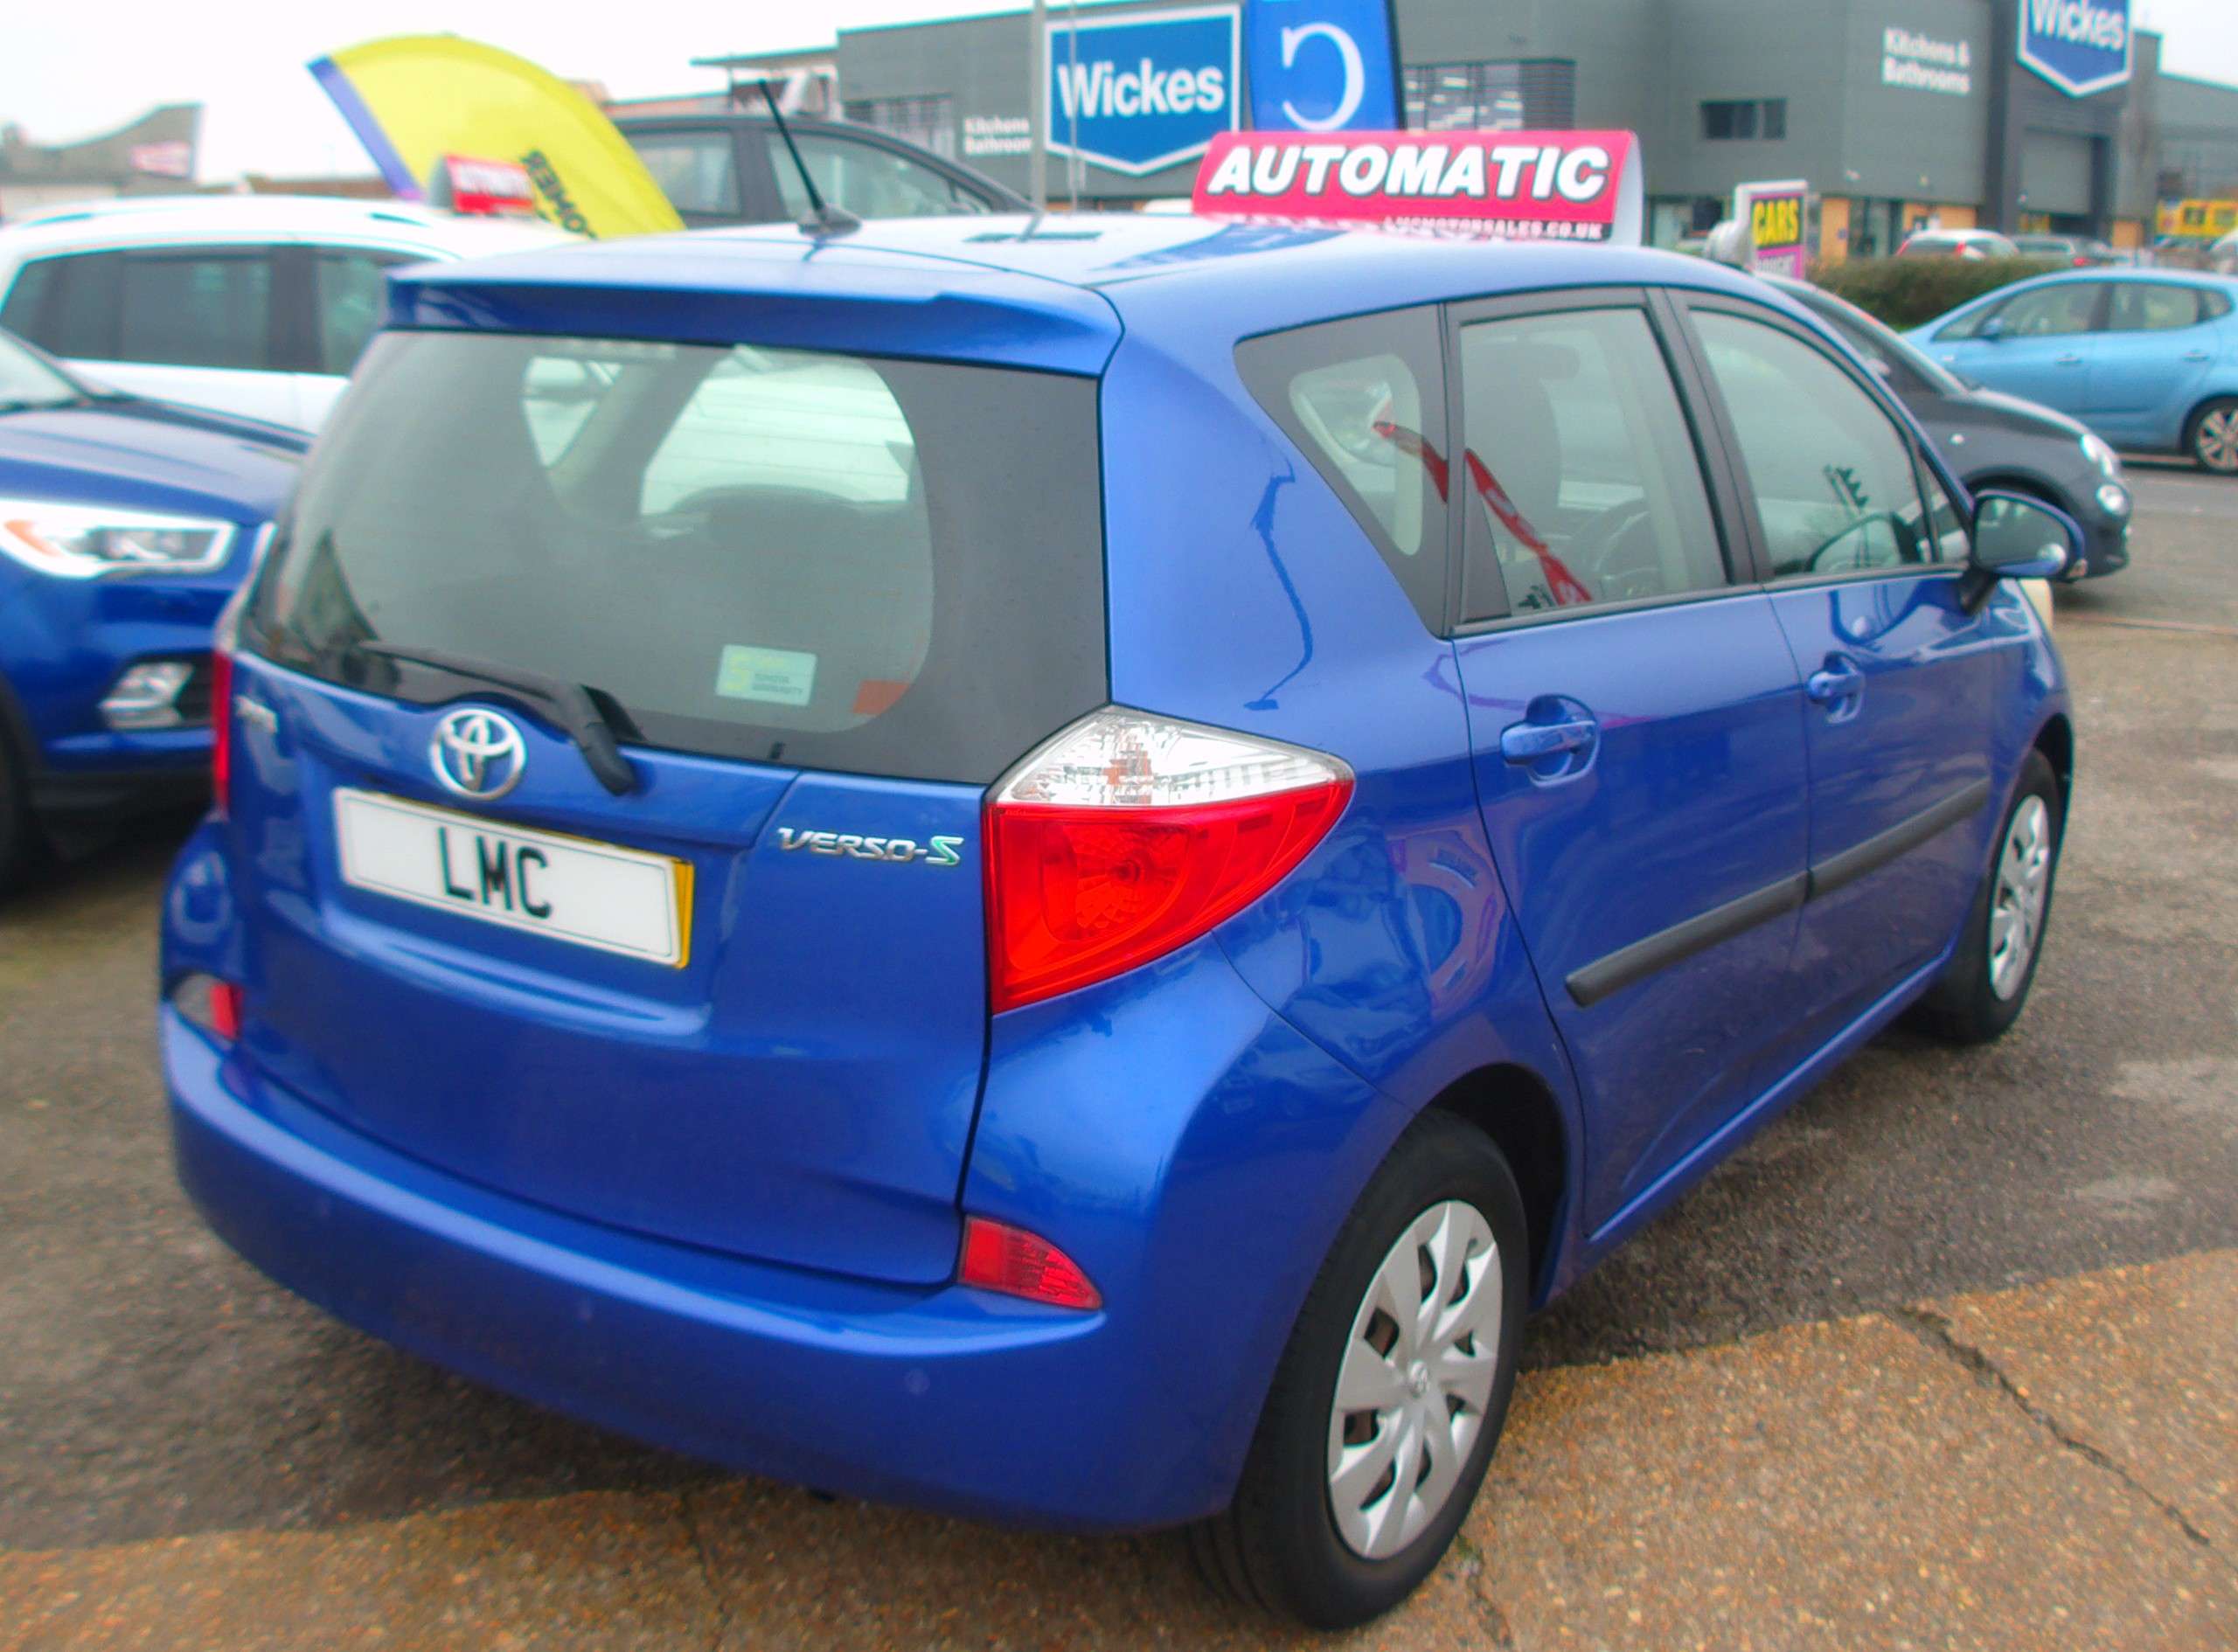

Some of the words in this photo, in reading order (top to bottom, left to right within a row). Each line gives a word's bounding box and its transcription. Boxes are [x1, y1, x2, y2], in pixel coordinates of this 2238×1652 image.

[2032, 0, 2123, 49] Wickes
[1057, 58, 1225, 117] Wickes
[1206, 145, 1610, 202] AUTOMATIC
[1752, 199, 1799, 246] CARS
[777, 827, 964, 865] VERSO-S
[438, 826, 553, 920] LMC
